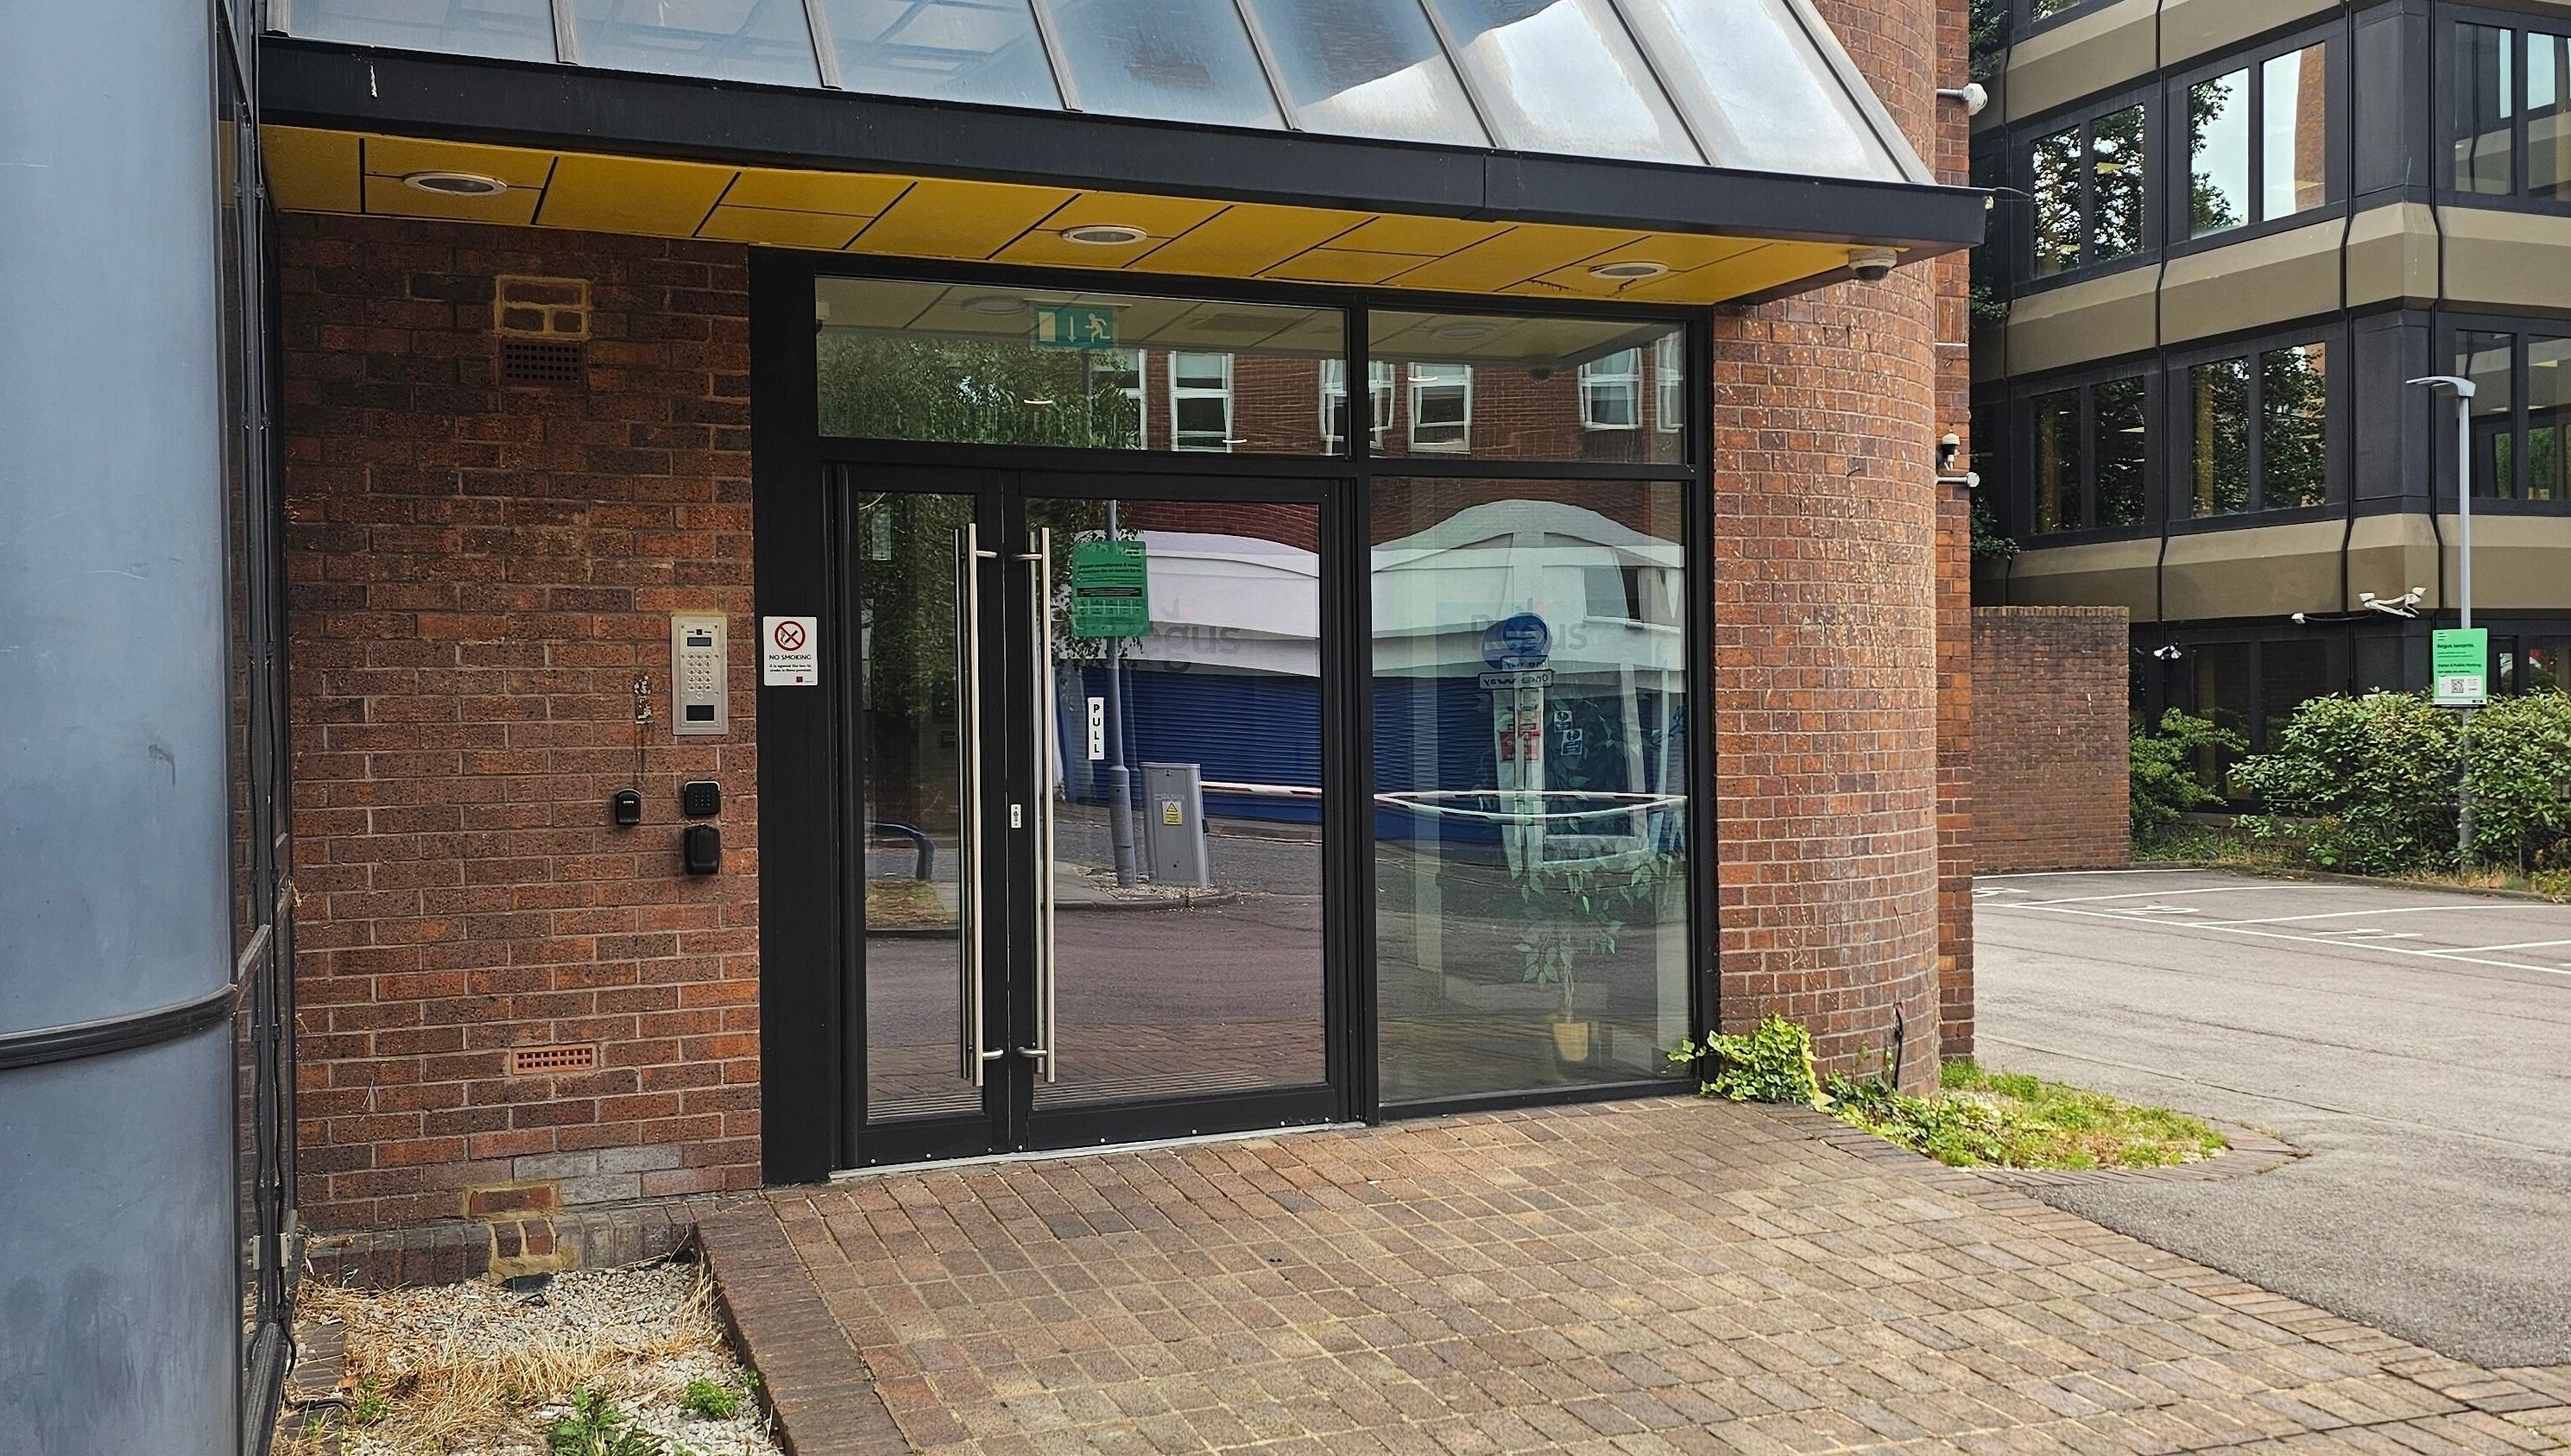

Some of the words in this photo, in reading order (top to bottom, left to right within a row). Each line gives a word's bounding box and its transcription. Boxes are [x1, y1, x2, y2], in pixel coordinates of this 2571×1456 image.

[1471, 614, 1588, 651] Rus
[1092, 703, 1101, 753] PULL
[2104, 904, 2200, 916] 12
[2308, 928, 2424, 940] 11
